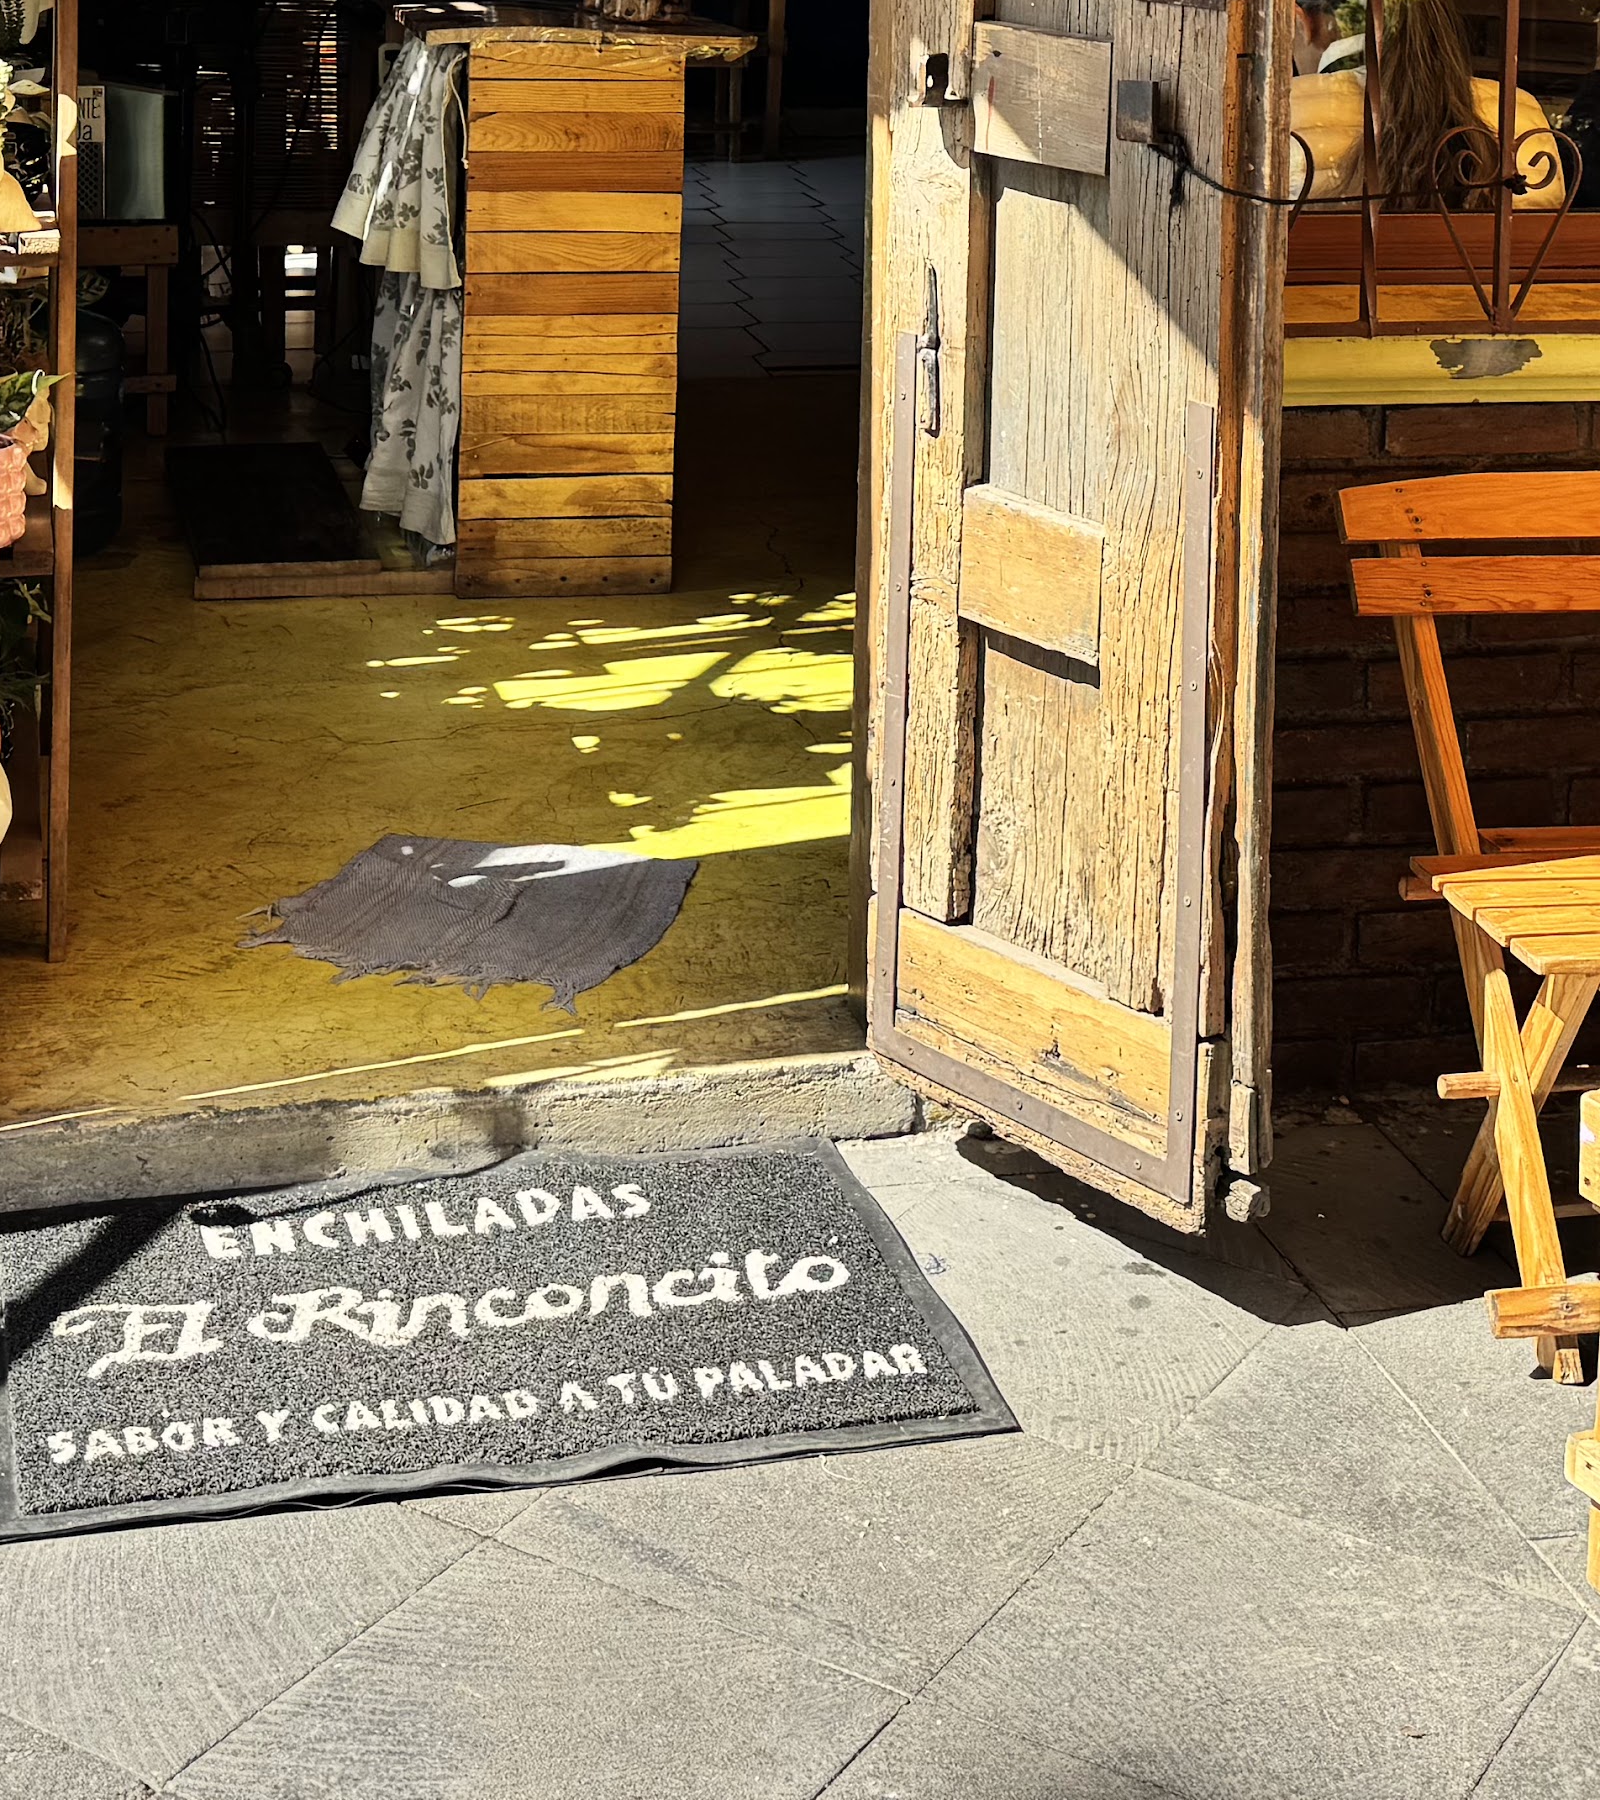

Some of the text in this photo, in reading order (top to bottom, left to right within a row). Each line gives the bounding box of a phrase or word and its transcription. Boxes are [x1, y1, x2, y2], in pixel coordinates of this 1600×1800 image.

[200, 1183, 652, 1259] ENCHILADAS
[52, 1246, 850, 1379] El Rinconcito
[256, 1408, 291, 1444] Y
[311, 1389, 540, 1436] CALIDAD
[558, 1380, 599, 1414] A
[694, 1343, 928, 1398] PALADAR
